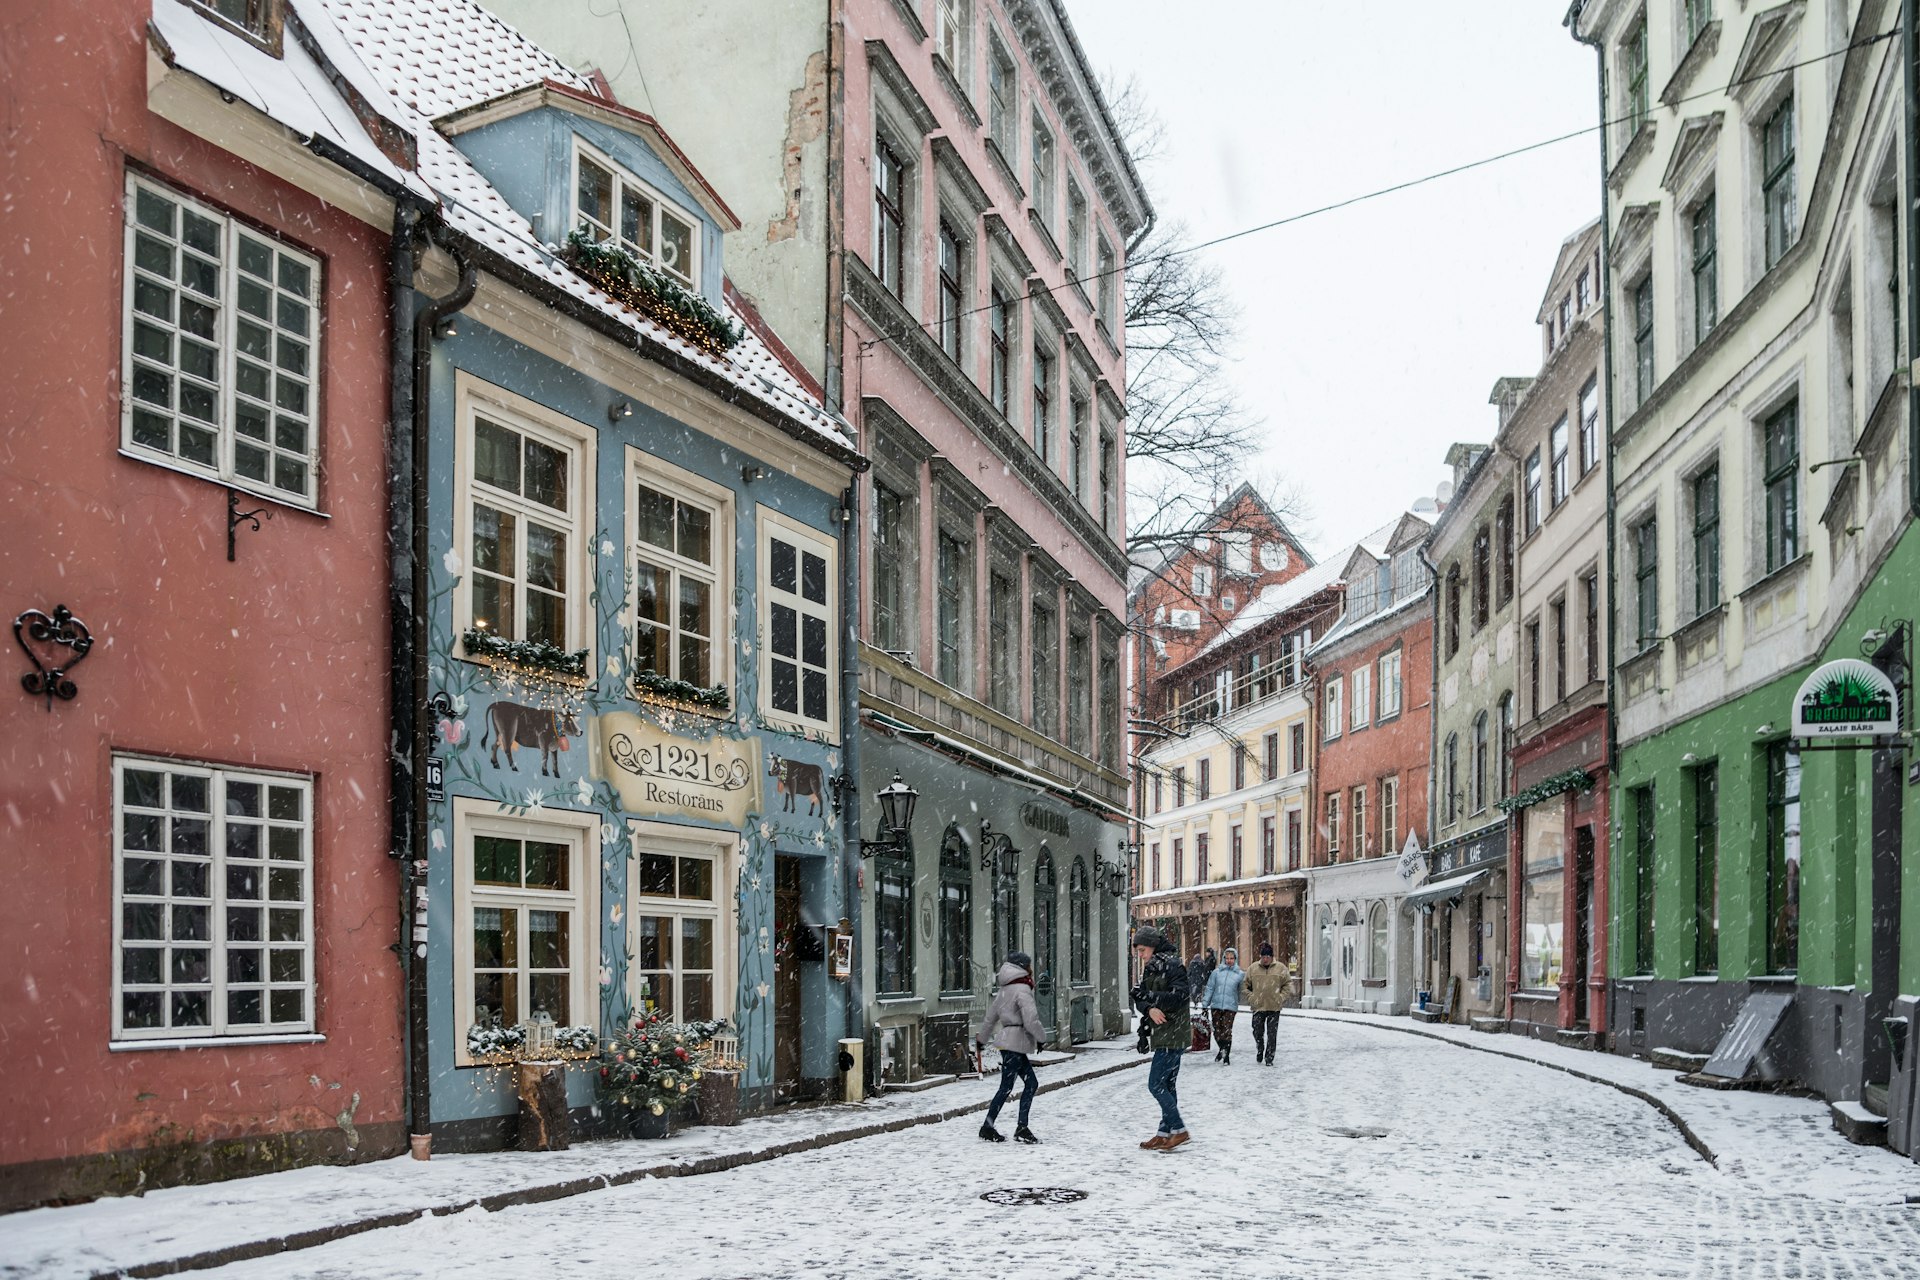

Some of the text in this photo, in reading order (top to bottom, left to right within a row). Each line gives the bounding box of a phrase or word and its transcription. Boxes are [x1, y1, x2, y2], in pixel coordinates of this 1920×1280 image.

[427, 766, 441, 785] 16
[653, 743, 713, 783] 1221
[645, 781, 724, 812] Restorāns
[1144, 891, 1275, 917] CUBA CAFE
